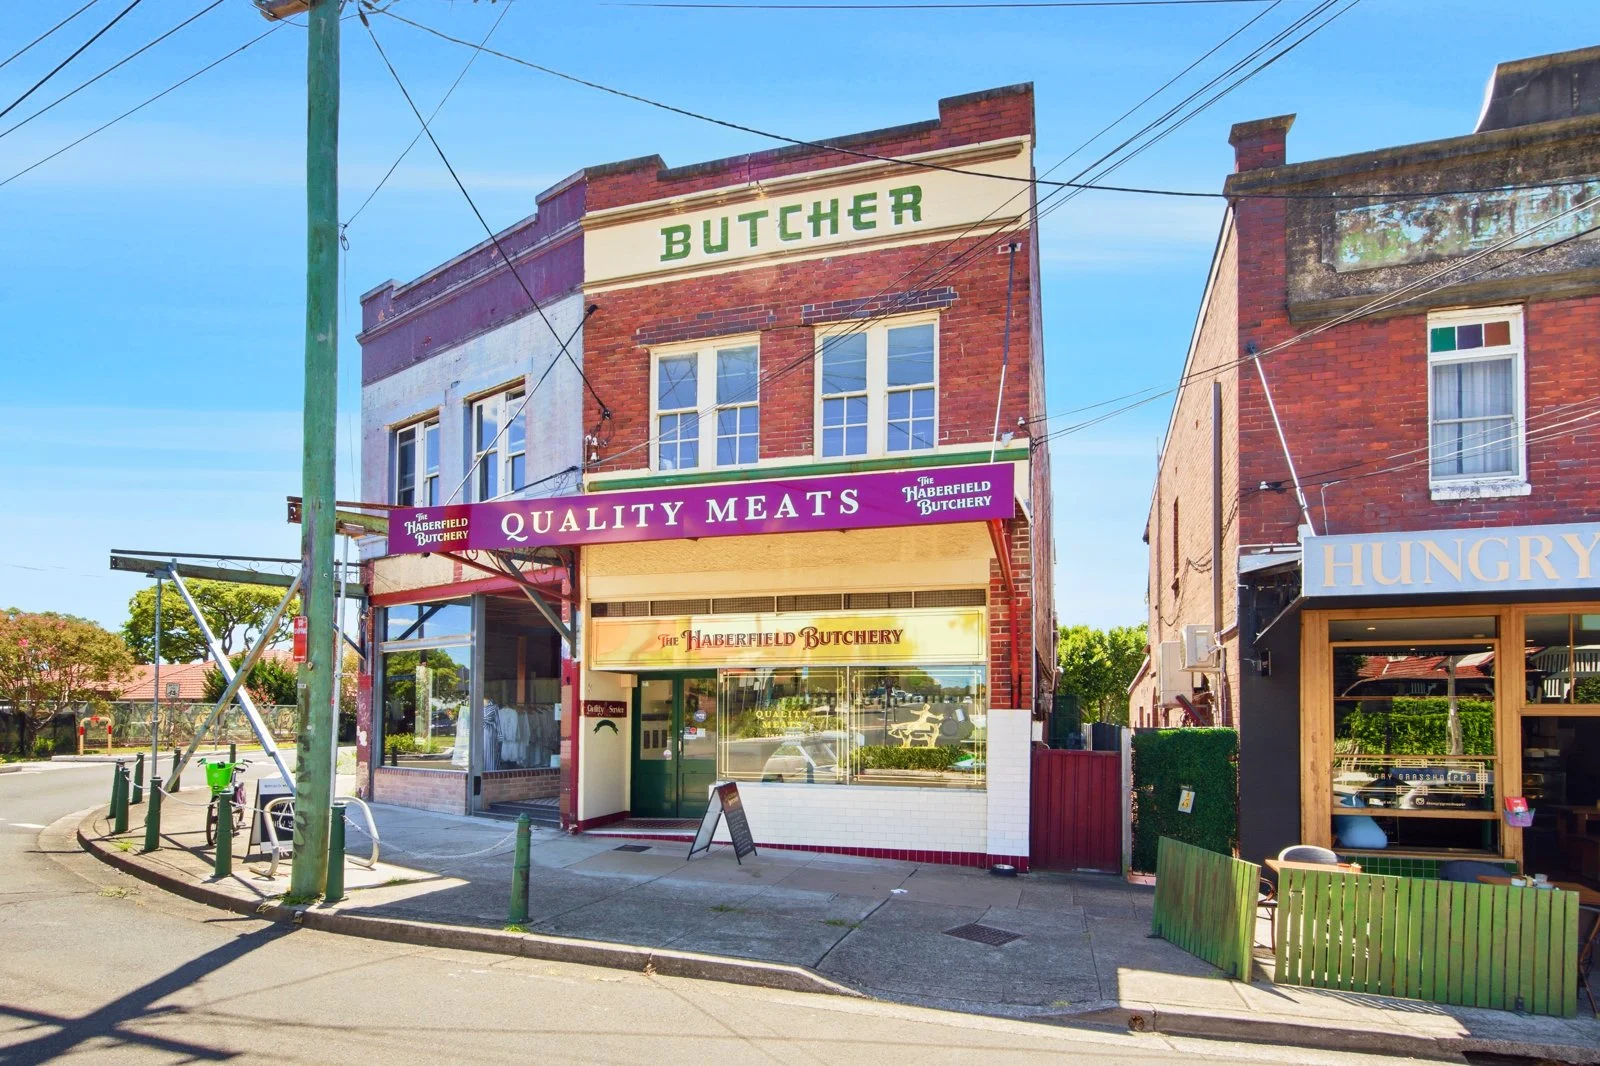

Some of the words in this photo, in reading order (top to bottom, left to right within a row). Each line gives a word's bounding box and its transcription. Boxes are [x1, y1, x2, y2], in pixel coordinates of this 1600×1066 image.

[660, 185, 922, 262] BUTCHER
[902, 480, 991, 502] HABERFIELD
[501, 501, 684, 541] QUALITY
[705, 489, 859, 523] MEATS
[917, 495, 992, 515] BUTCHERY
[404, 518, 468, 535] HABERFIELD
[415, 530, 469, 546] BUTCHERY
[1322, 532, 1600, 587] HUNGRY
[681, 630, 795, 652] HABERFIELD
[798, 626, 903, 650] BUTCHERY
[755, 710, 809, 719] QUALITY
[762, 721, 802, 729] MEATS
